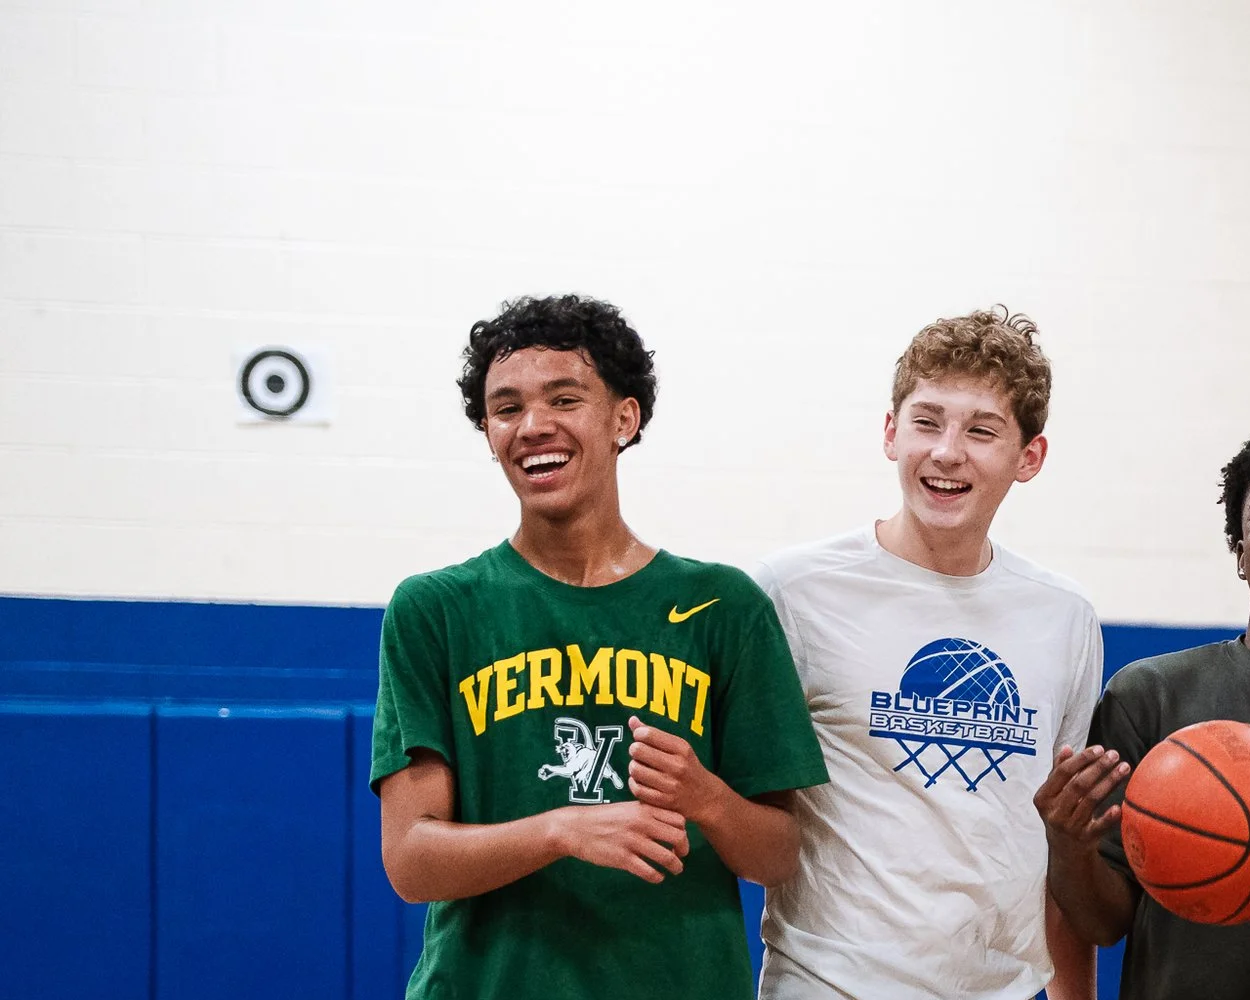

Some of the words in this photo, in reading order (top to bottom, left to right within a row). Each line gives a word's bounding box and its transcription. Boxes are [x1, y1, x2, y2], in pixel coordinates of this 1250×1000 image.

[459, 644, 711, 736] VERMONT
[871, 691, 1038, 725] BLUEPRINT
[870, 712, 1036, 745] BASKETBALL
